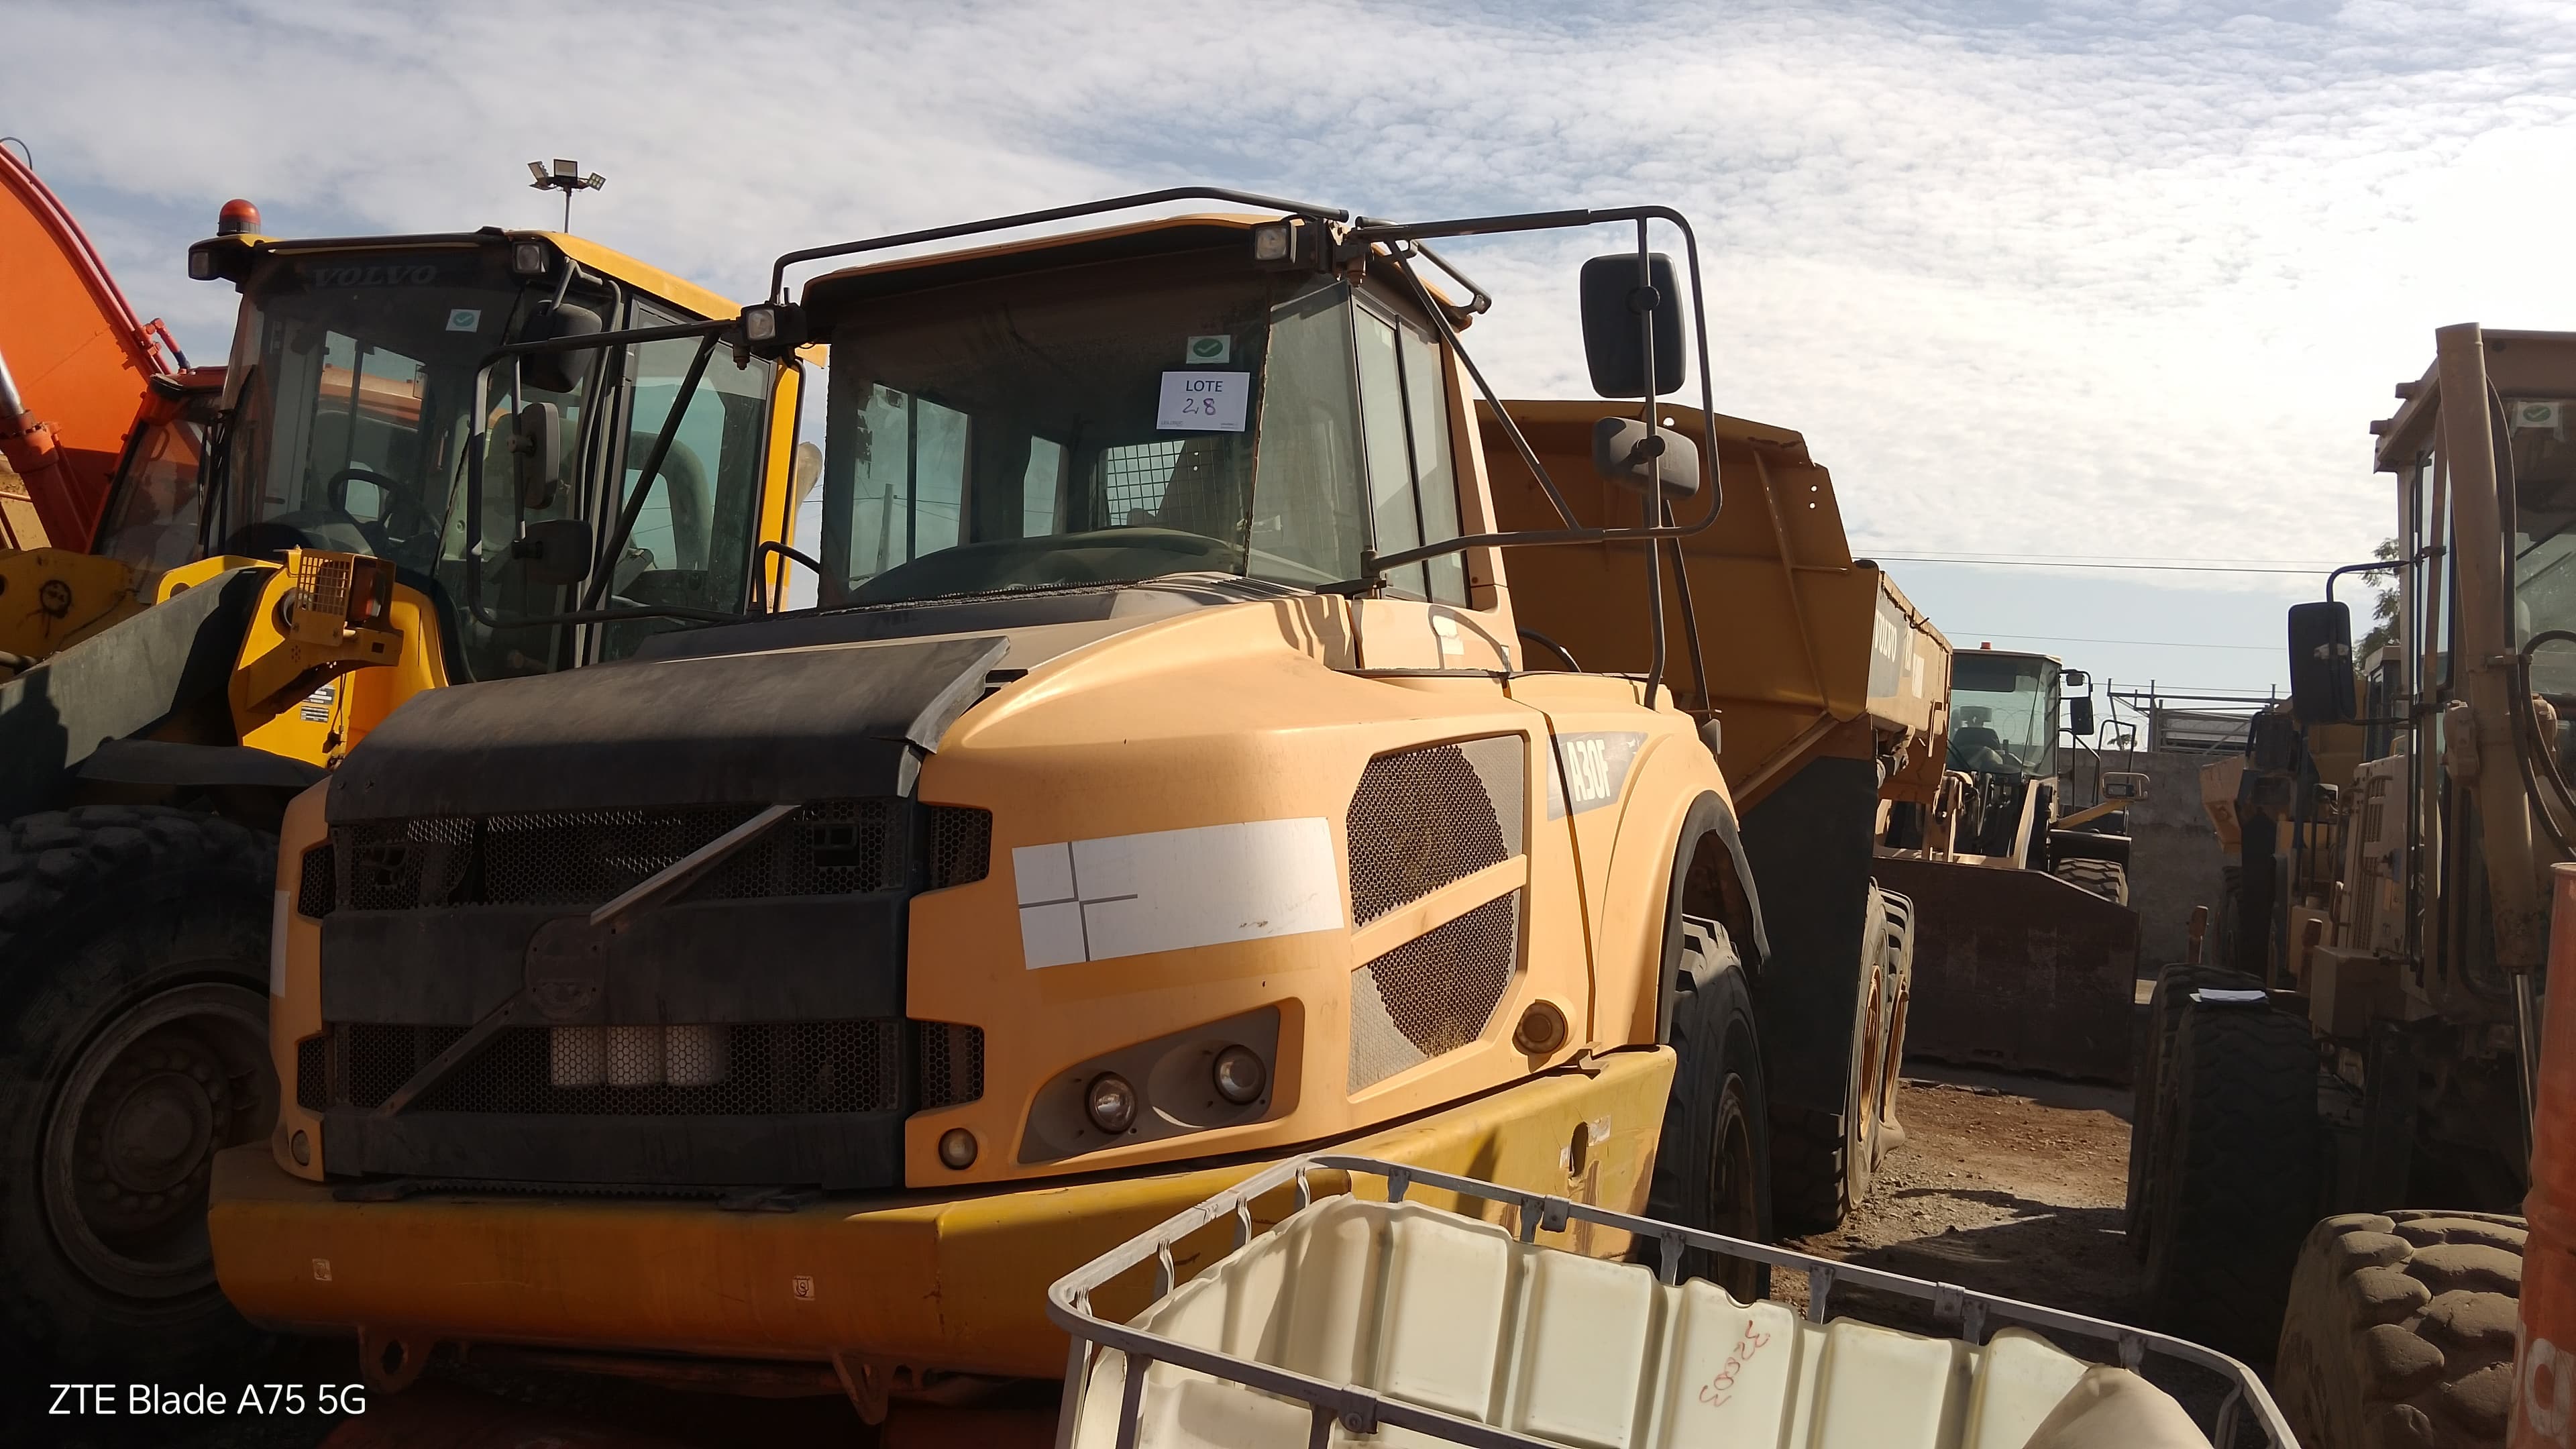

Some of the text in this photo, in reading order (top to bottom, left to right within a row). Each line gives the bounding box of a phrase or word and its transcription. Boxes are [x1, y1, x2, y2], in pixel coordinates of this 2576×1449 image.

[312, 265, 437, 287] VOLVO
[1185, 380, 1224, 392] LOTE
[1874, 609, 1898, 663] VOLVO
[1566, 739, 1611, 802] A30F
